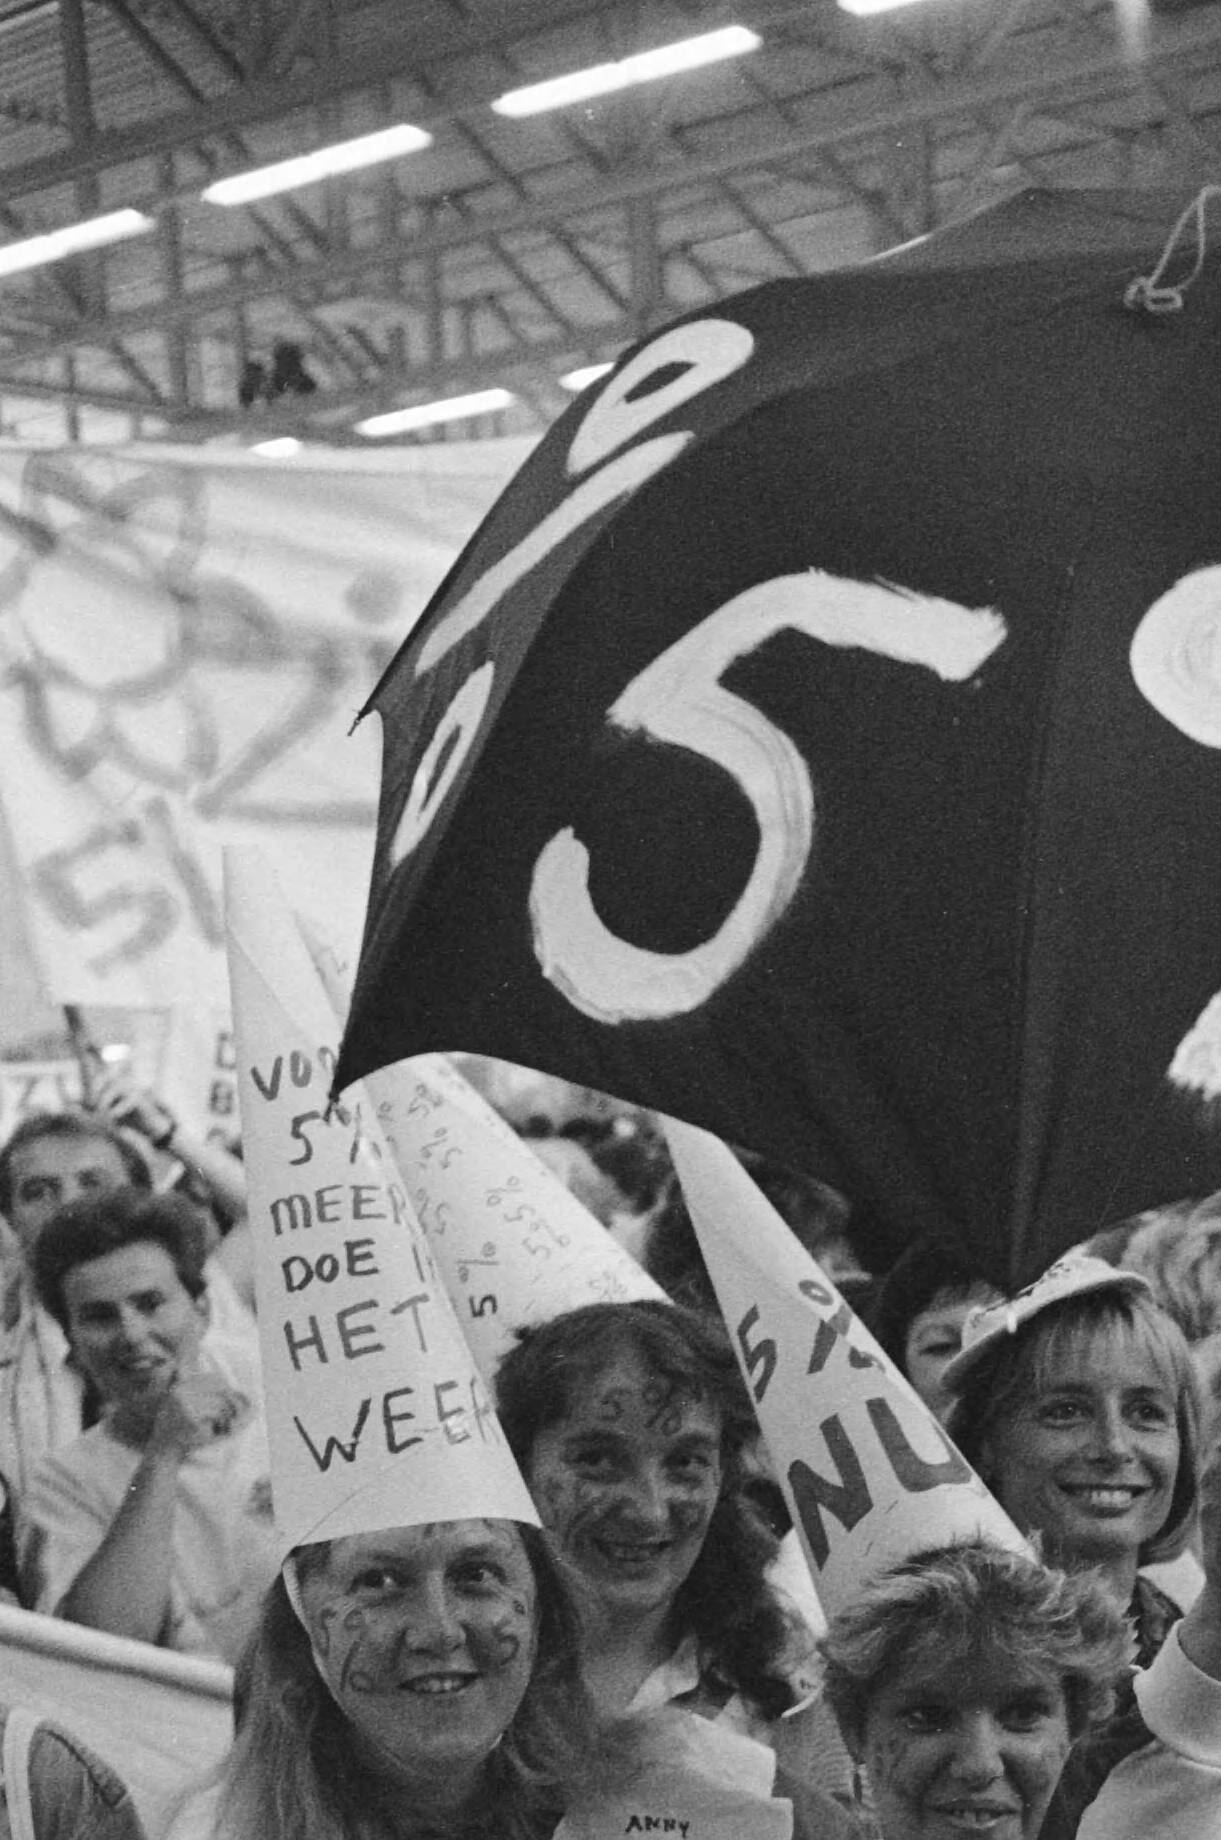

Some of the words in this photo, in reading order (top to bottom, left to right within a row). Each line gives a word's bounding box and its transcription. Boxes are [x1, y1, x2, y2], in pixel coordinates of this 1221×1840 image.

[281, 1237, 380, 1293] DOE
[283, 1292, 430, 1372] HET
[787, 1396, 974, 1572] NU
[625, 1814, 691, 1840] ANNY
